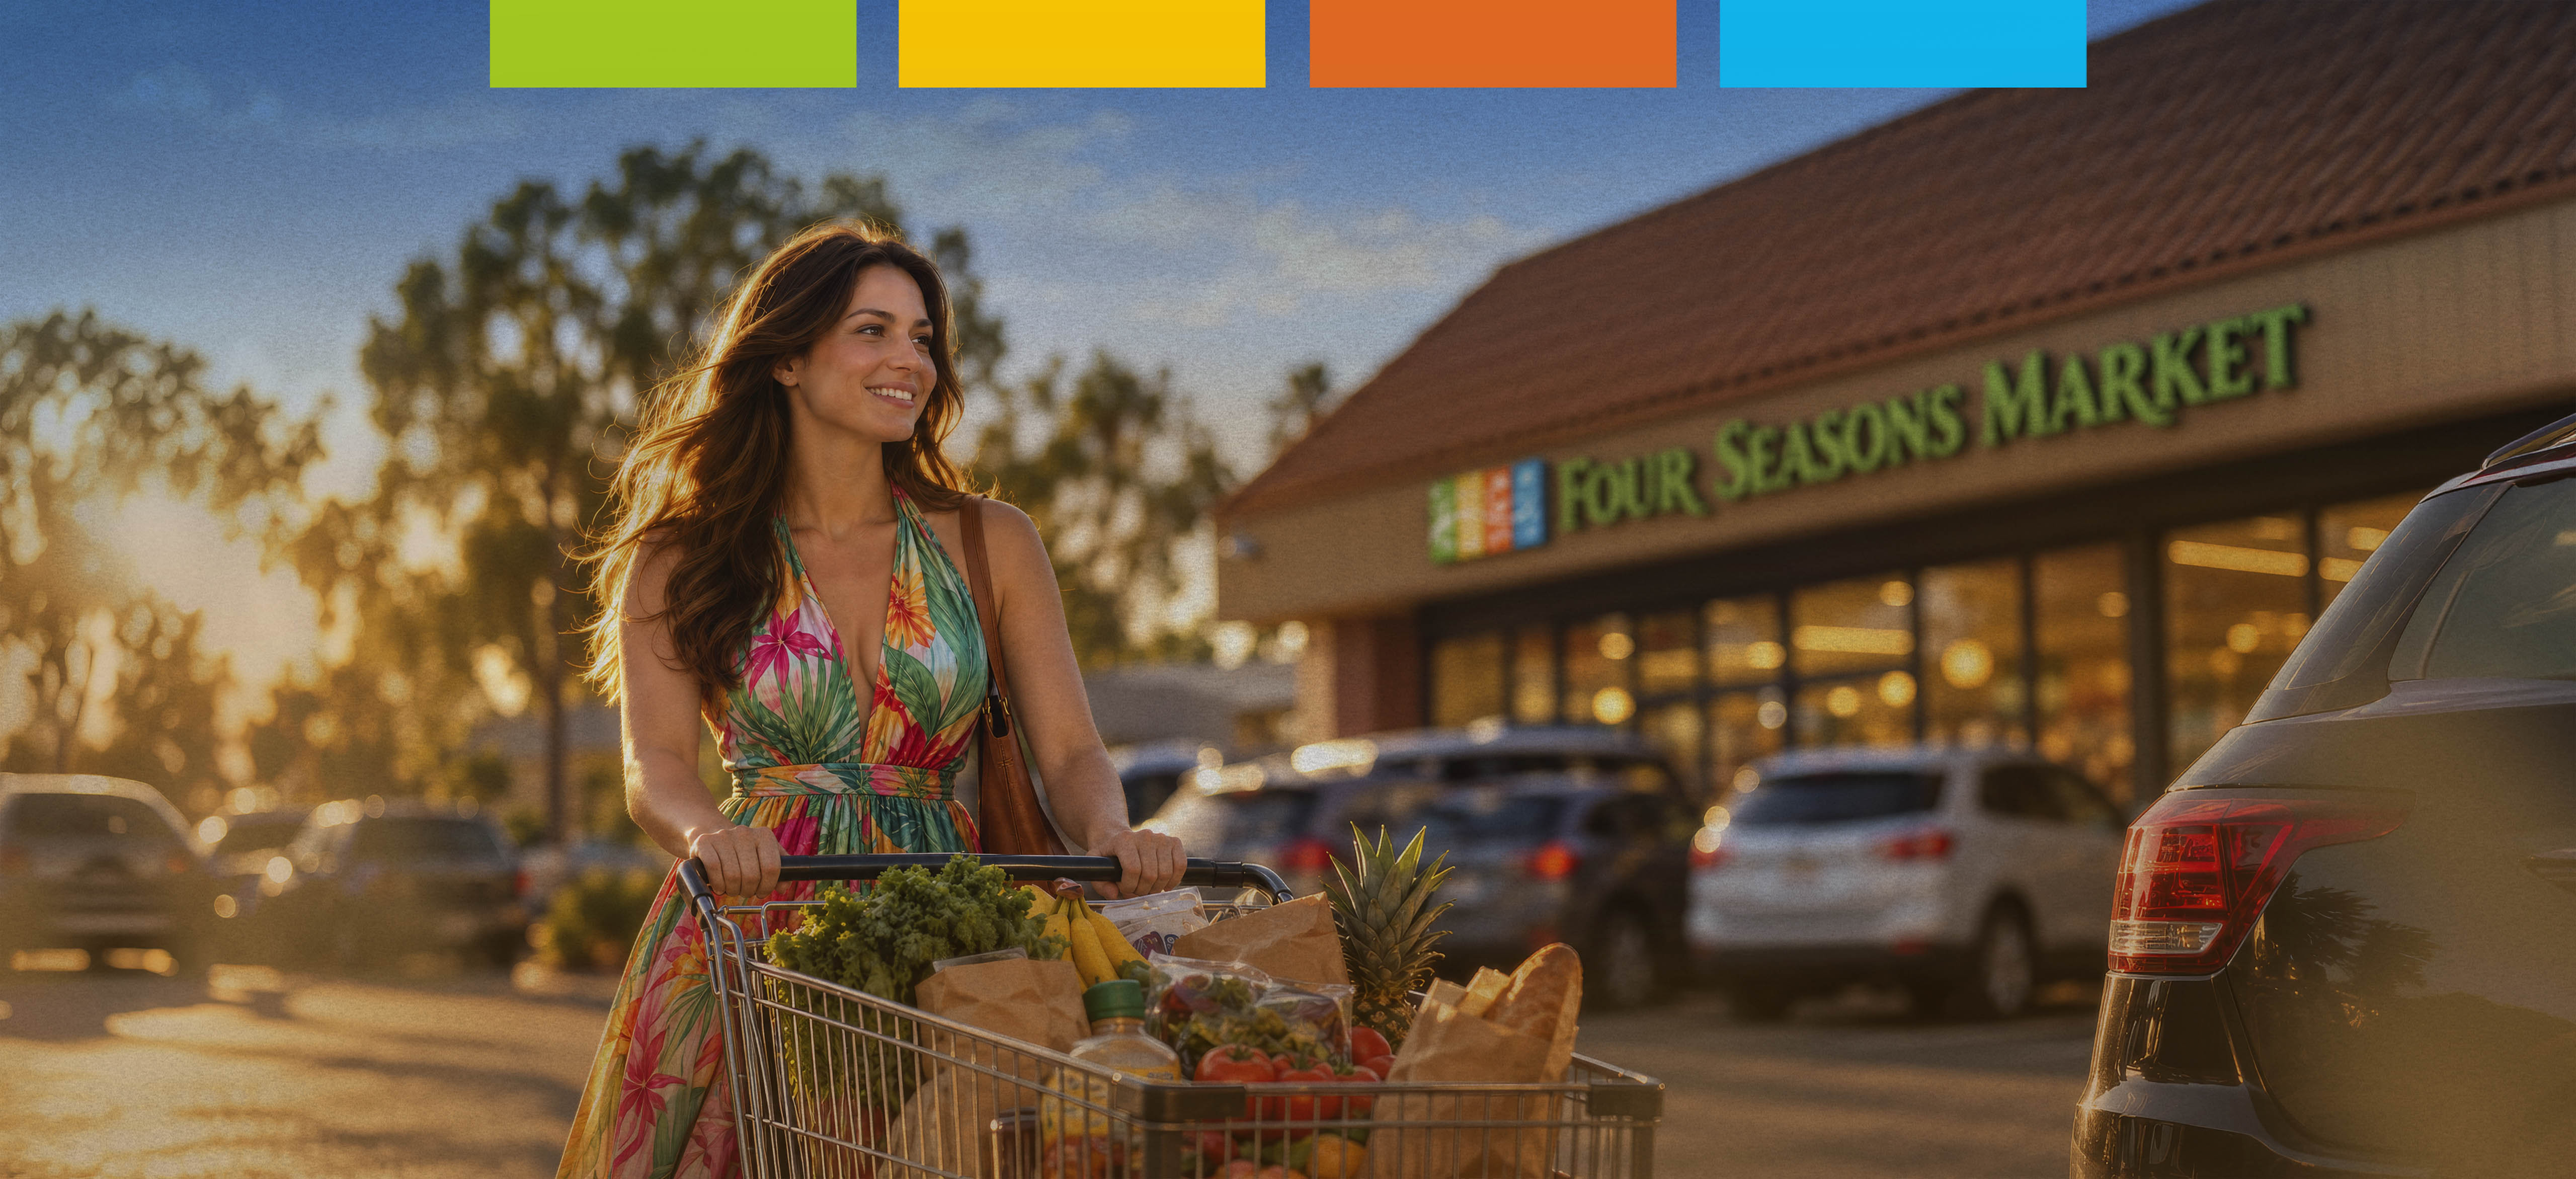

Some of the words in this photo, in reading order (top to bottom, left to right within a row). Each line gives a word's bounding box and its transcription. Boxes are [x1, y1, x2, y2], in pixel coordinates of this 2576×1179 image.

[1557, 449, 1709, 531] FOUR
[1714, 385, 1963, 499] SEASONS
[1981, 304, 2305, 446] MARKET
